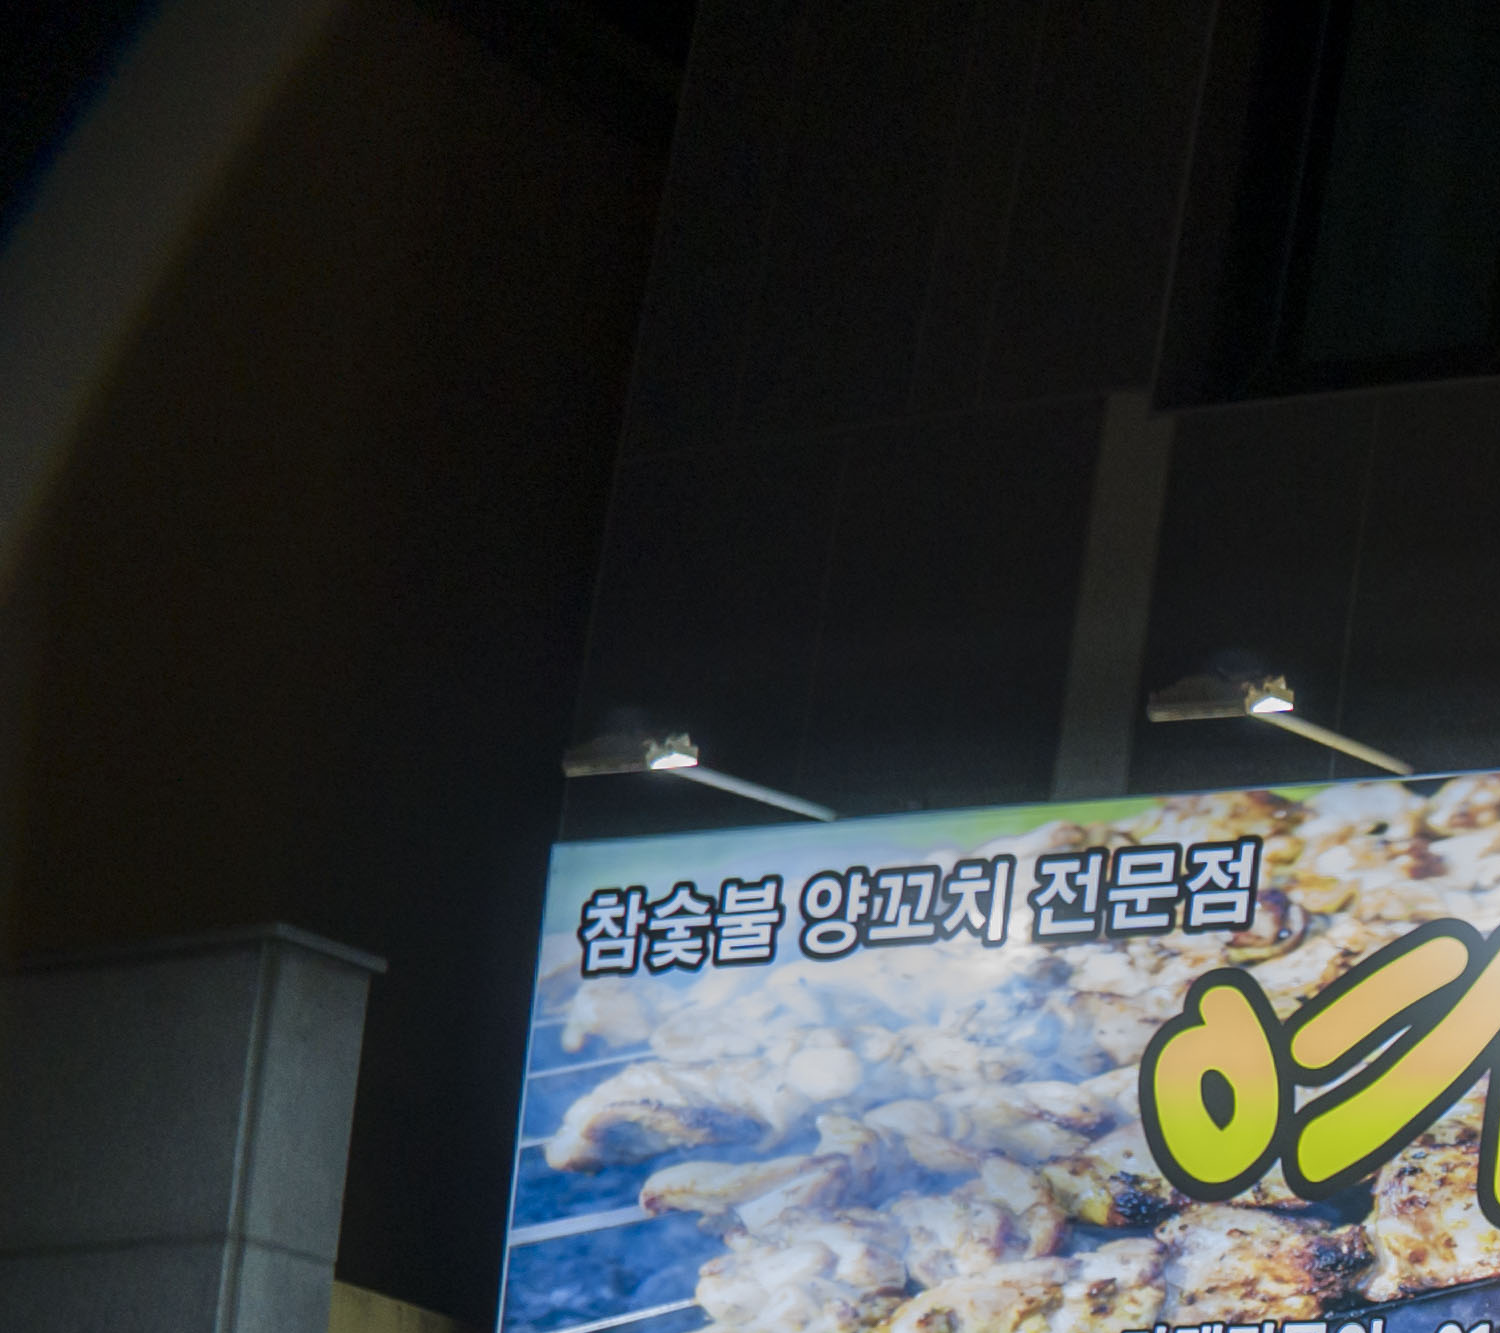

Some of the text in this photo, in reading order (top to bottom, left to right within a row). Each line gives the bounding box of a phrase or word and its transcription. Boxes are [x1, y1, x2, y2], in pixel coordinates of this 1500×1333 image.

[582, 836, 1263, 978] 참숯불 양꼬치 전문점
